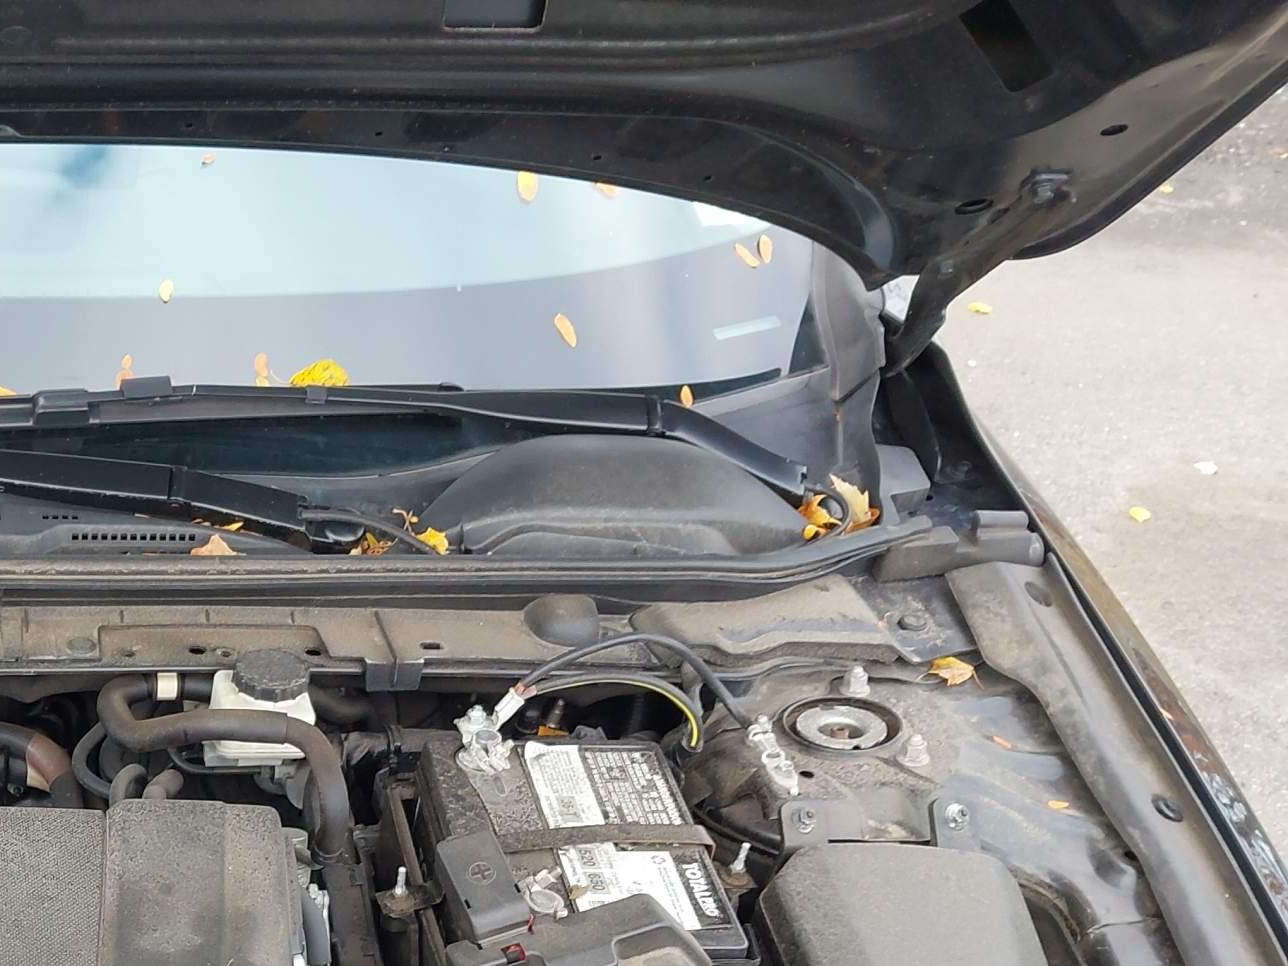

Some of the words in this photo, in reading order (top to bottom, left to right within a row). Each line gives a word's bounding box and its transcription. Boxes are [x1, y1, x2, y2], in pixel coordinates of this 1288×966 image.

[578, 849, 596, 867] 520
[588, 873, 606, 891] 650
[682, 862, 721, 917] TOTALPRO
